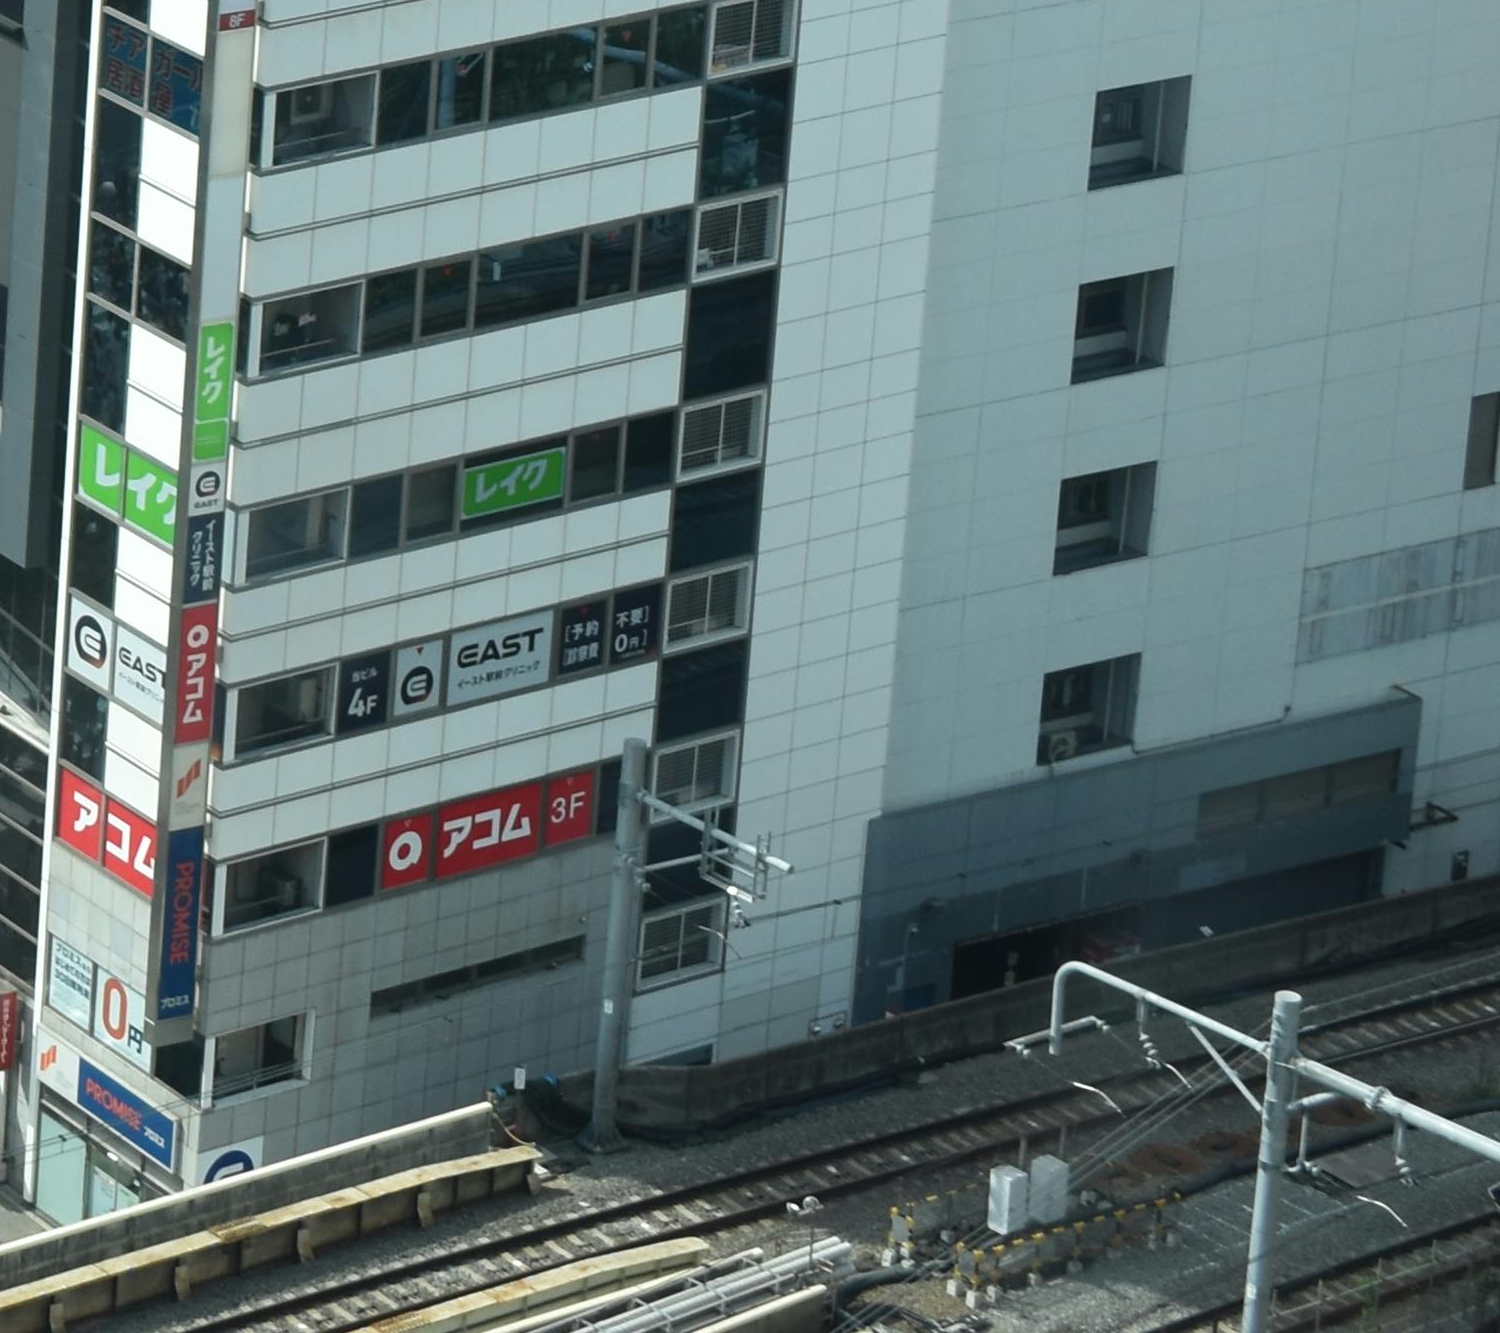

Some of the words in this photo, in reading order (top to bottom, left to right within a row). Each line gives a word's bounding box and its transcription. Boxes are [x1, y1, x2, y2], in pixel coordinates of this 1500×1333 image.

[228, 11, 246, 29] 8F
[201, 336, 226, 406] レイク
[473, 458, 548, 504] レイク
[455, 628, 545, 670] EAST
[184, 657, 207, 725] アコム
[346, 688, 379, 720] 4F
[71, 789, 157, 874] アコム
[441, 802, 533, 860] アコム
[549, 790, 586, 828] 3F
[169, 861, 195, 965] PROMISE
[102, 977, 144, 1055] 0円
[160, 994, 191, 1010] プロミス
[83, 1060, 146, 1129] PROMISE
